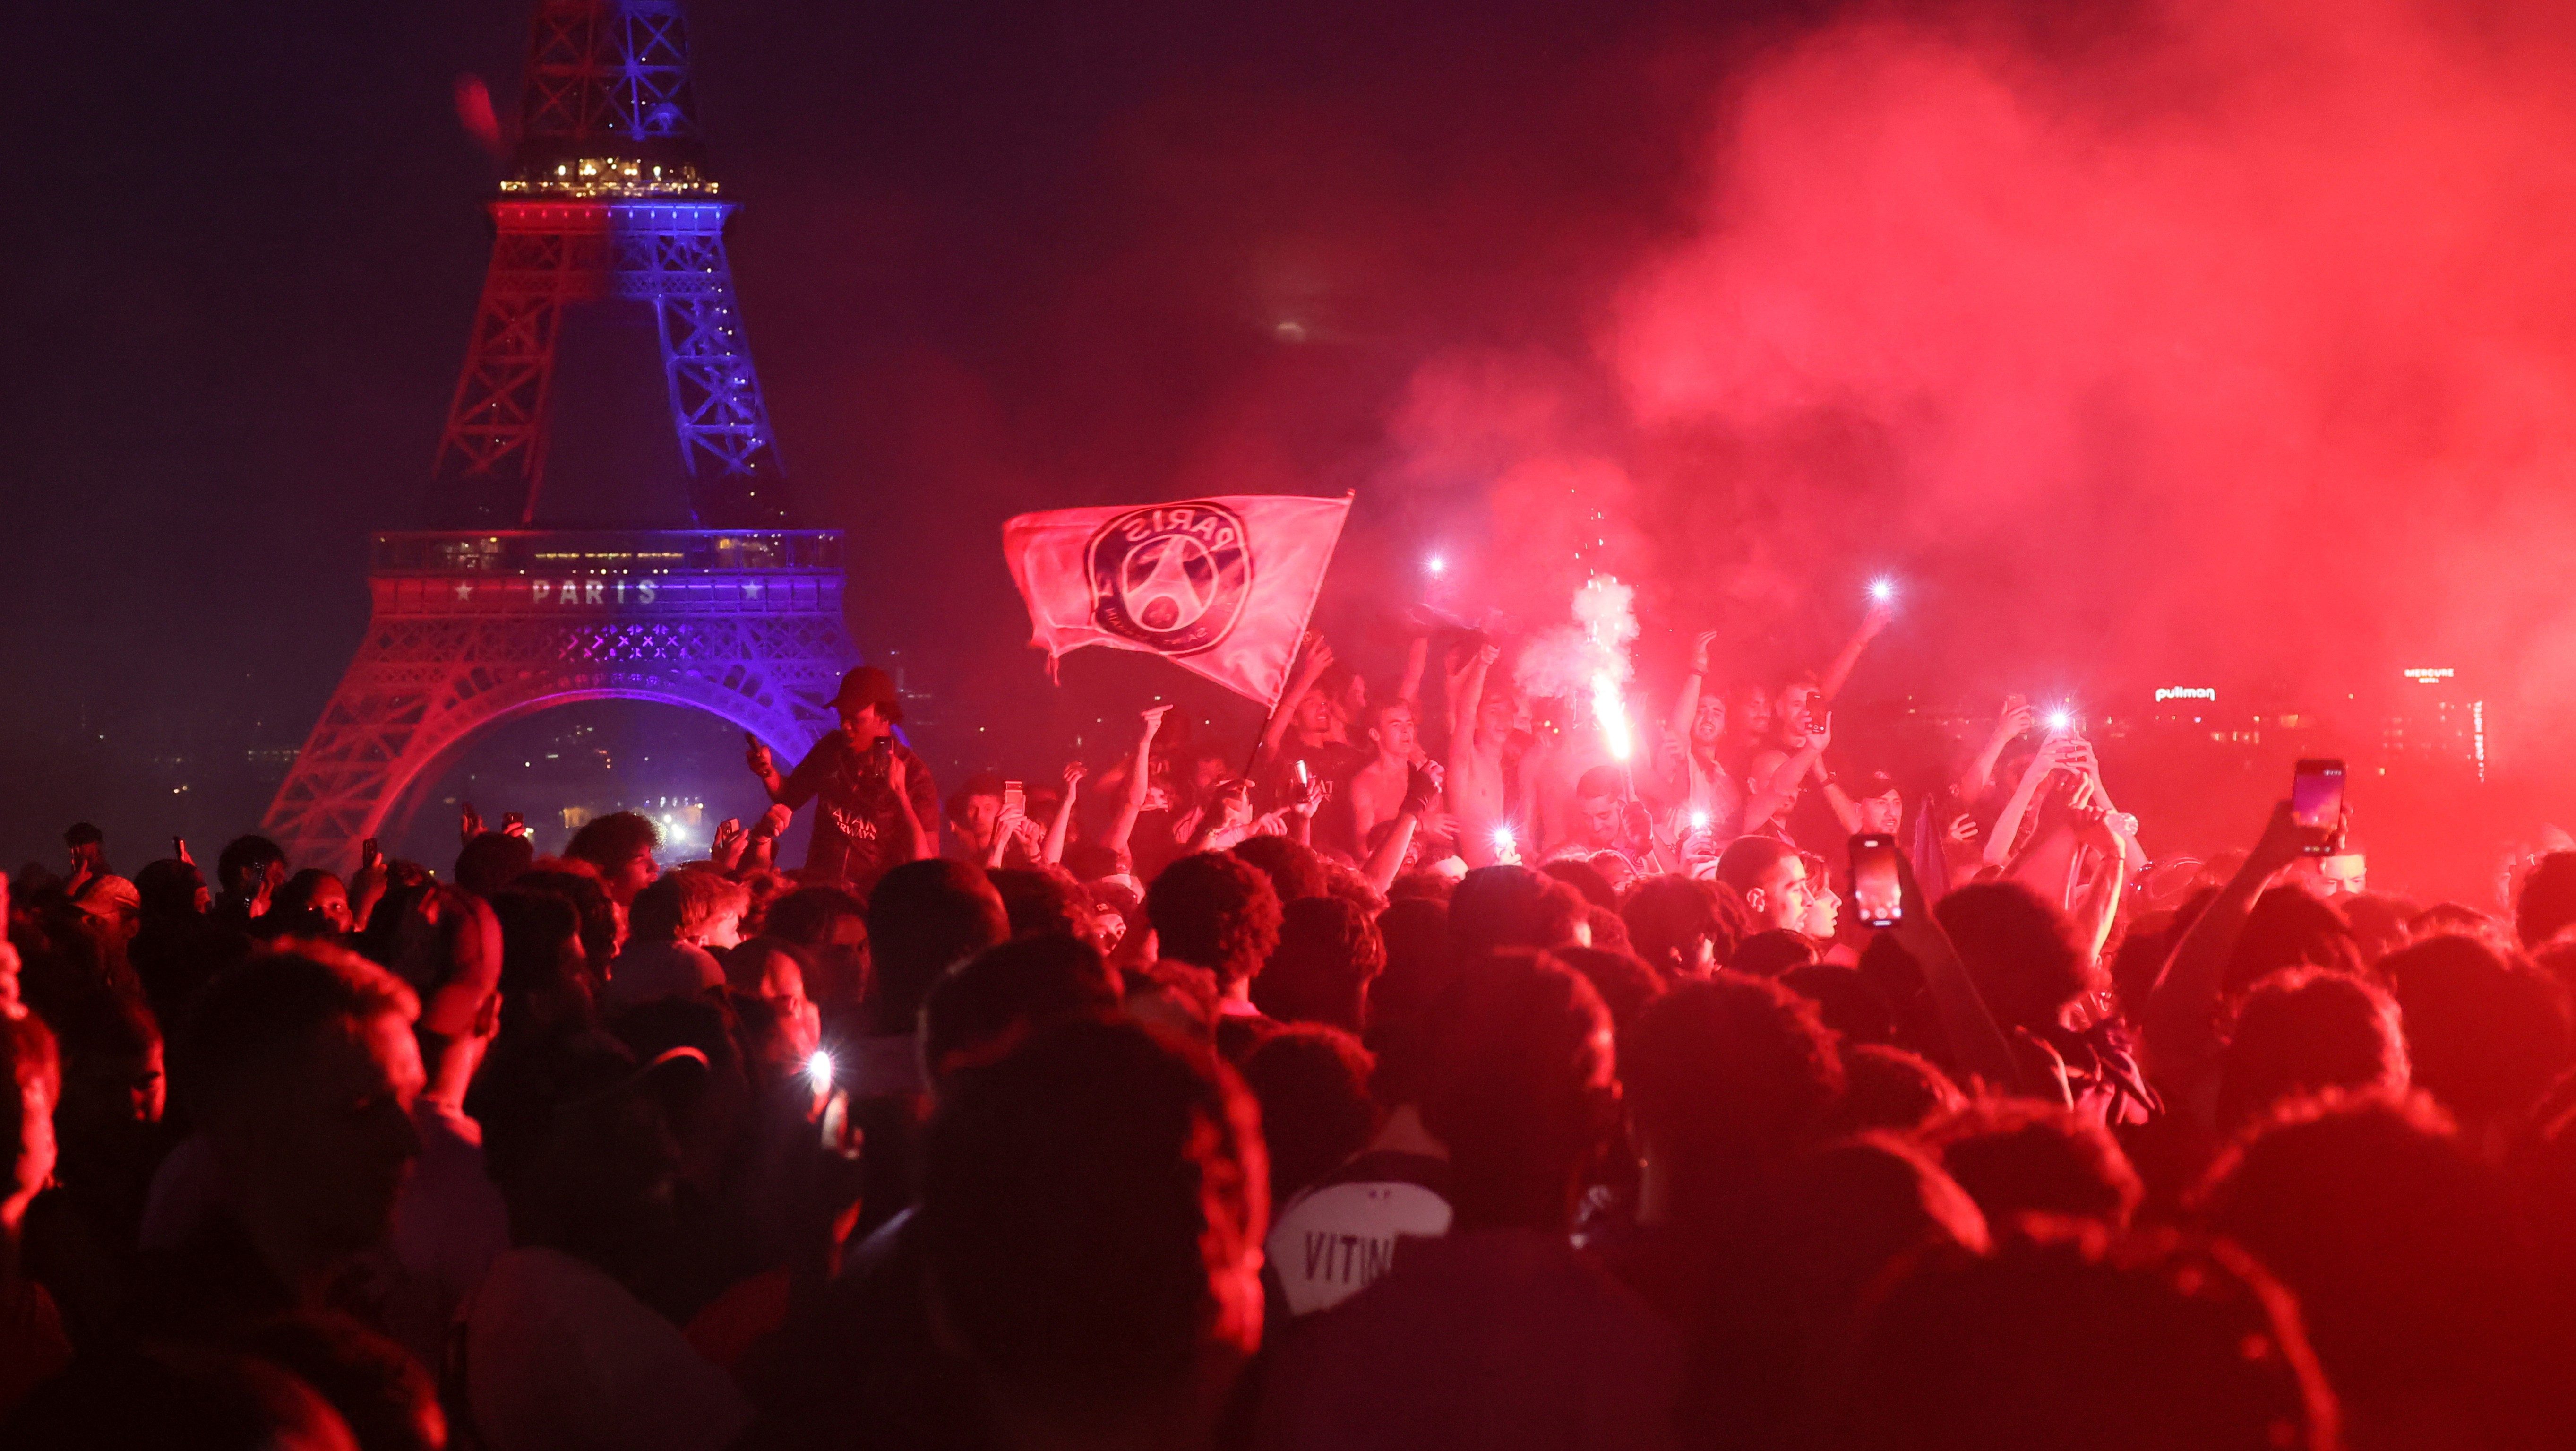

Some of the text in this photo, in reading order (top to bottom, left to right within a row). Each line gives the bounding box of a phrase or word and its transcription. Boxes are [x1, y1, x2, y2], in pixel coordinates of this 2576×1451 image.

[533, 579, 655, 604] PARIS
[2404, 668, 2454, 677] MERCURE
[2155, 686, 2215, 702] pullman
